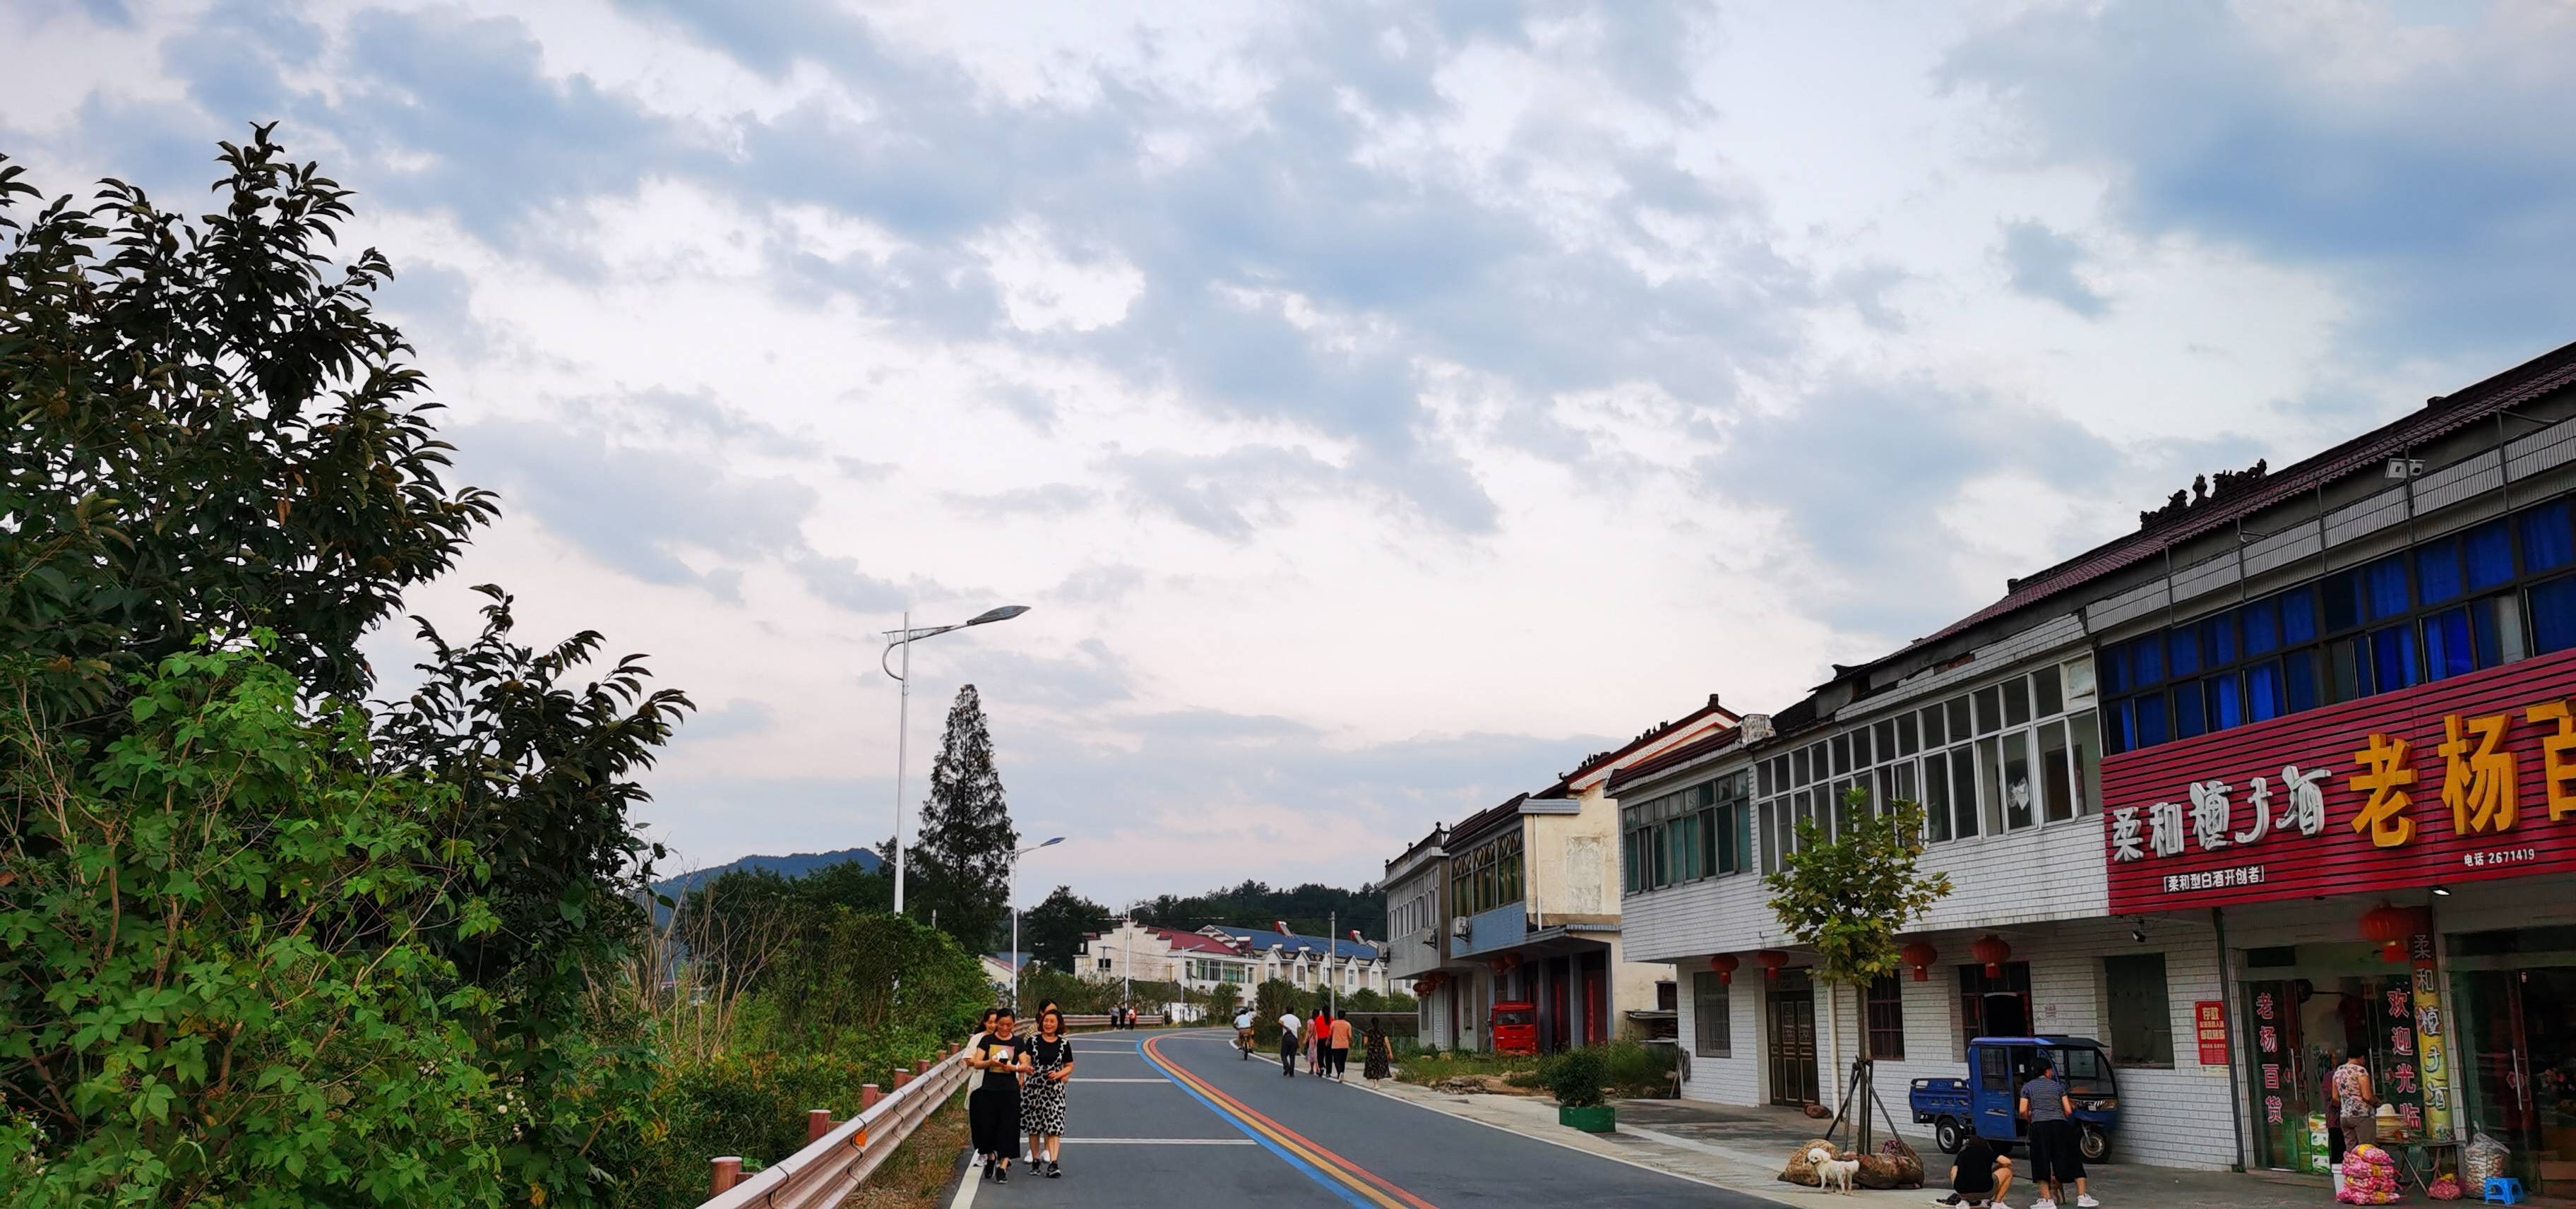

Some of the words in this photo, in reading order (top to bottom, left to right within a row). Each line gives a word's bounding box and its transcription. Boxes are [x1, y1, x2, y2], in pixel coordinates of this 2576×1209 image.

[2464, 852, 2484, 867] 电话
[2488, 848, 2535, 864] 2671419
[2255, 992, 2284, 1124] 老杨百货
[2387, 987, 2422, 1130] 欢迎光临
